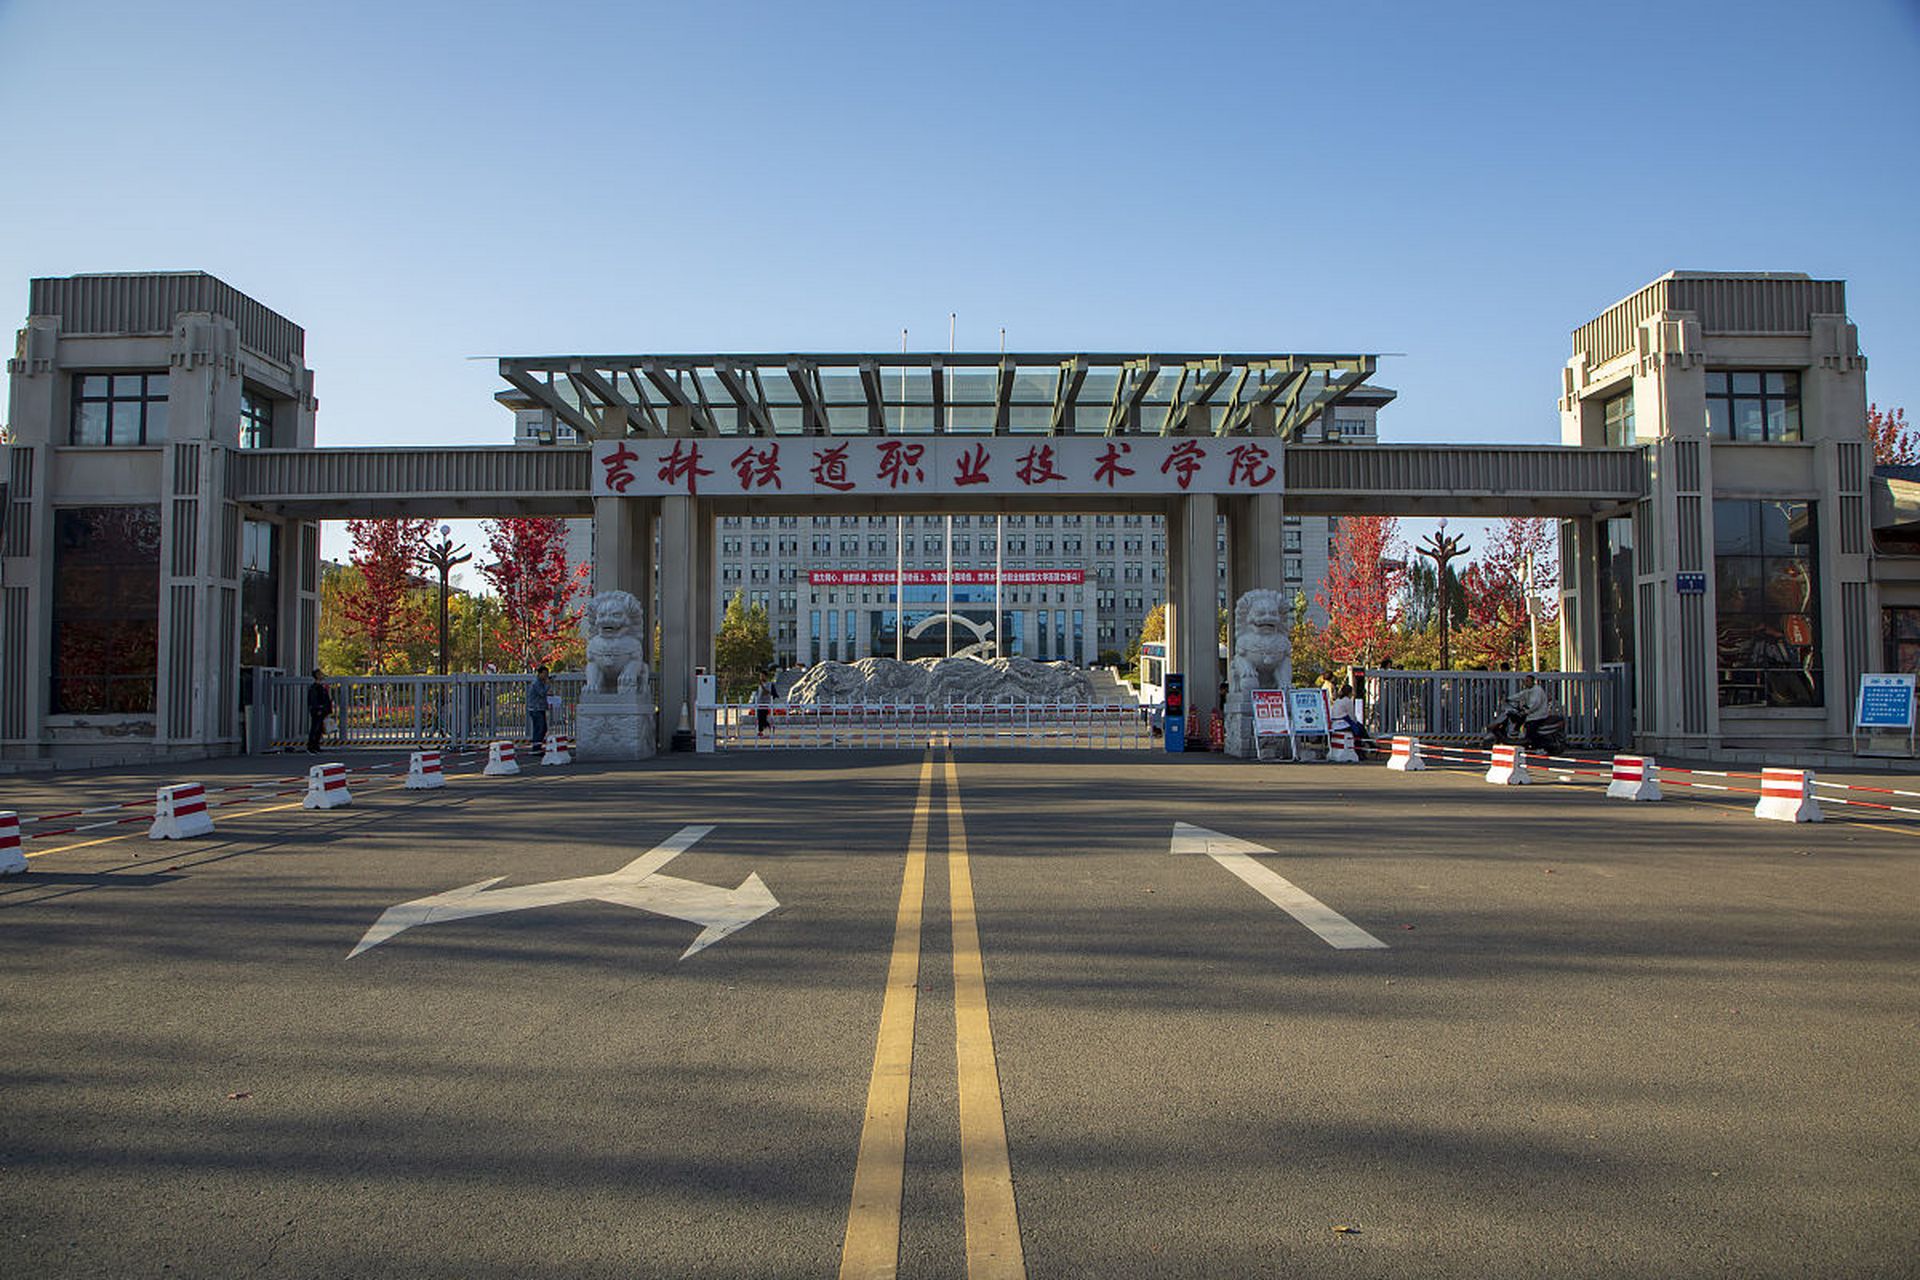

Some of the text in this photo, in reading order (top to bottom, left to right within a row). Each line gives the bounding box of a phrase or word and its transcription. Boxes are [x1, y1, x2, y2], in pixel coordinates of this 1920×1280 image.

[601, 439, 1276, 495] 吉林铁道职业技术学院
